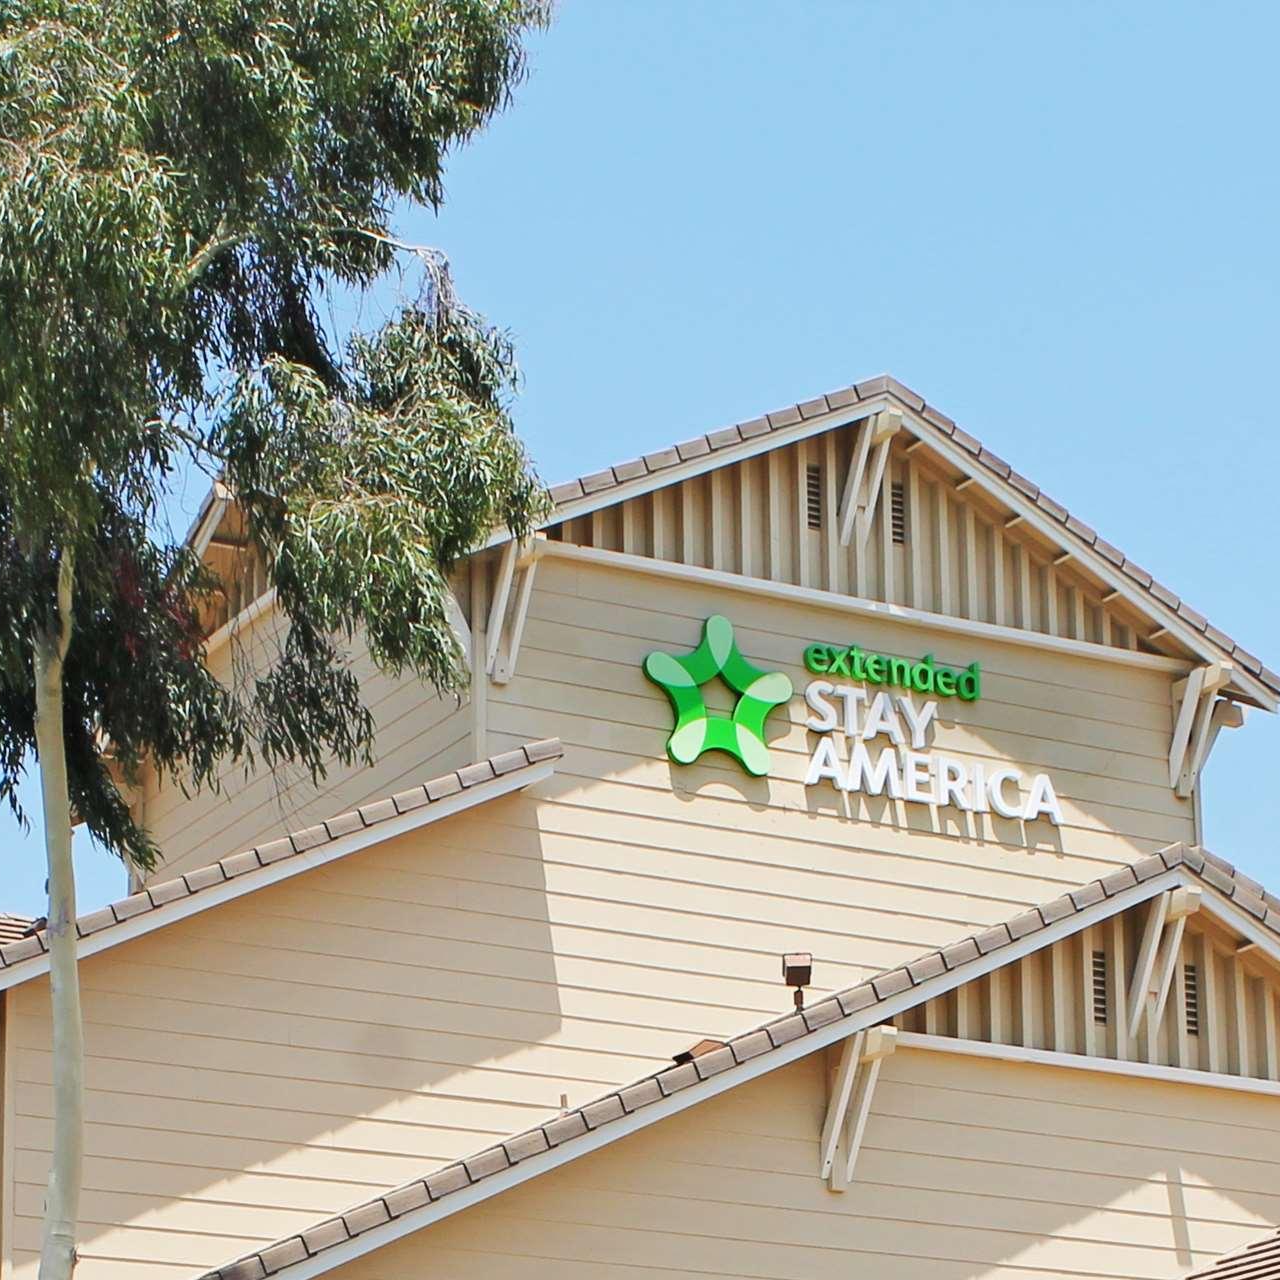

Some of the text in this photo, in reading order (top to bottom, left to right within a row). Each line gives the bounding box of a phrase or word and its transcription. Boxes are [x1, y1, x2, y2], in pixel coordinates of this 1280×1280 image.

[804, 643, 981, 700] extended
[805, 680, 938, 749] STAY
[805, 736, 1065, 825] AMERICA
